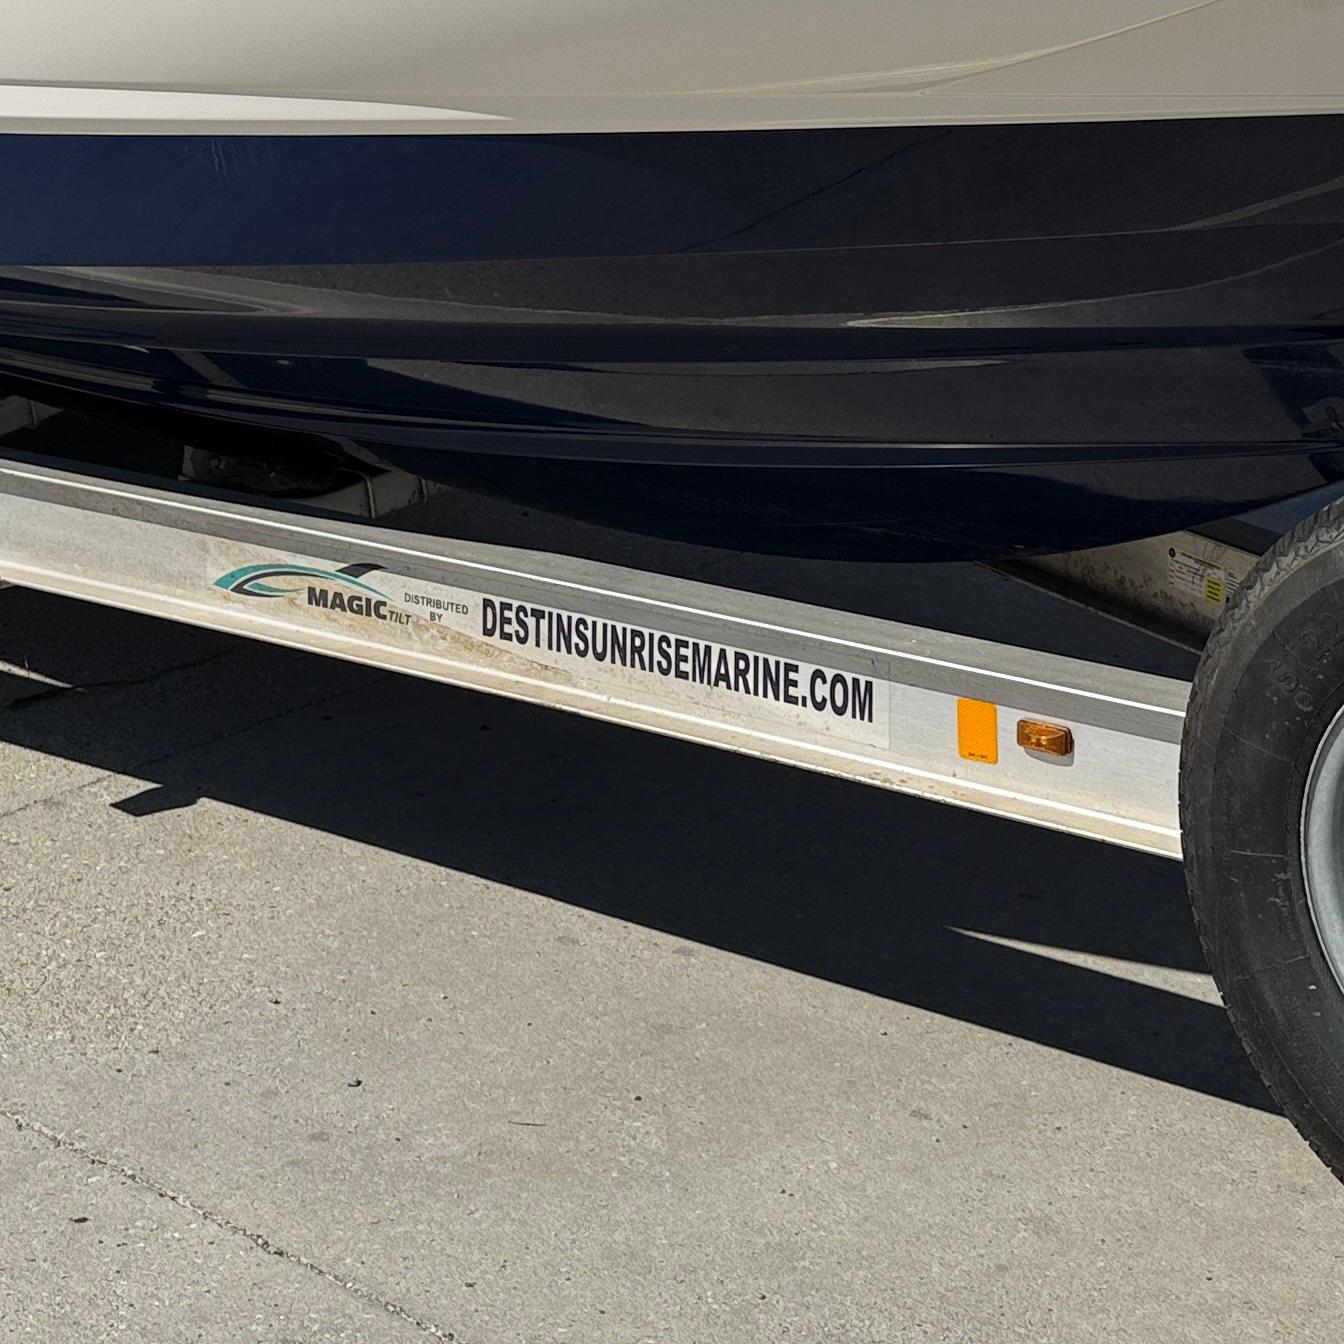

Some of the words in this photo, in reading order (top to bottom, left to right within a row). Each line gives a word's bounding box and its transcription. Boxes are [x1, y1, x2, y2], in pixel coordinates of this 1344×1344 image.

[307, 586, 388, 621] MAGIC
[388, 610, 413, 626] TILT
[404, 592, 469, 615] DISTRIBUTED
[429, 612, 444, 623] BY
[482, 597, 874, 724] DESTINSUNRISEMARINE.COM
